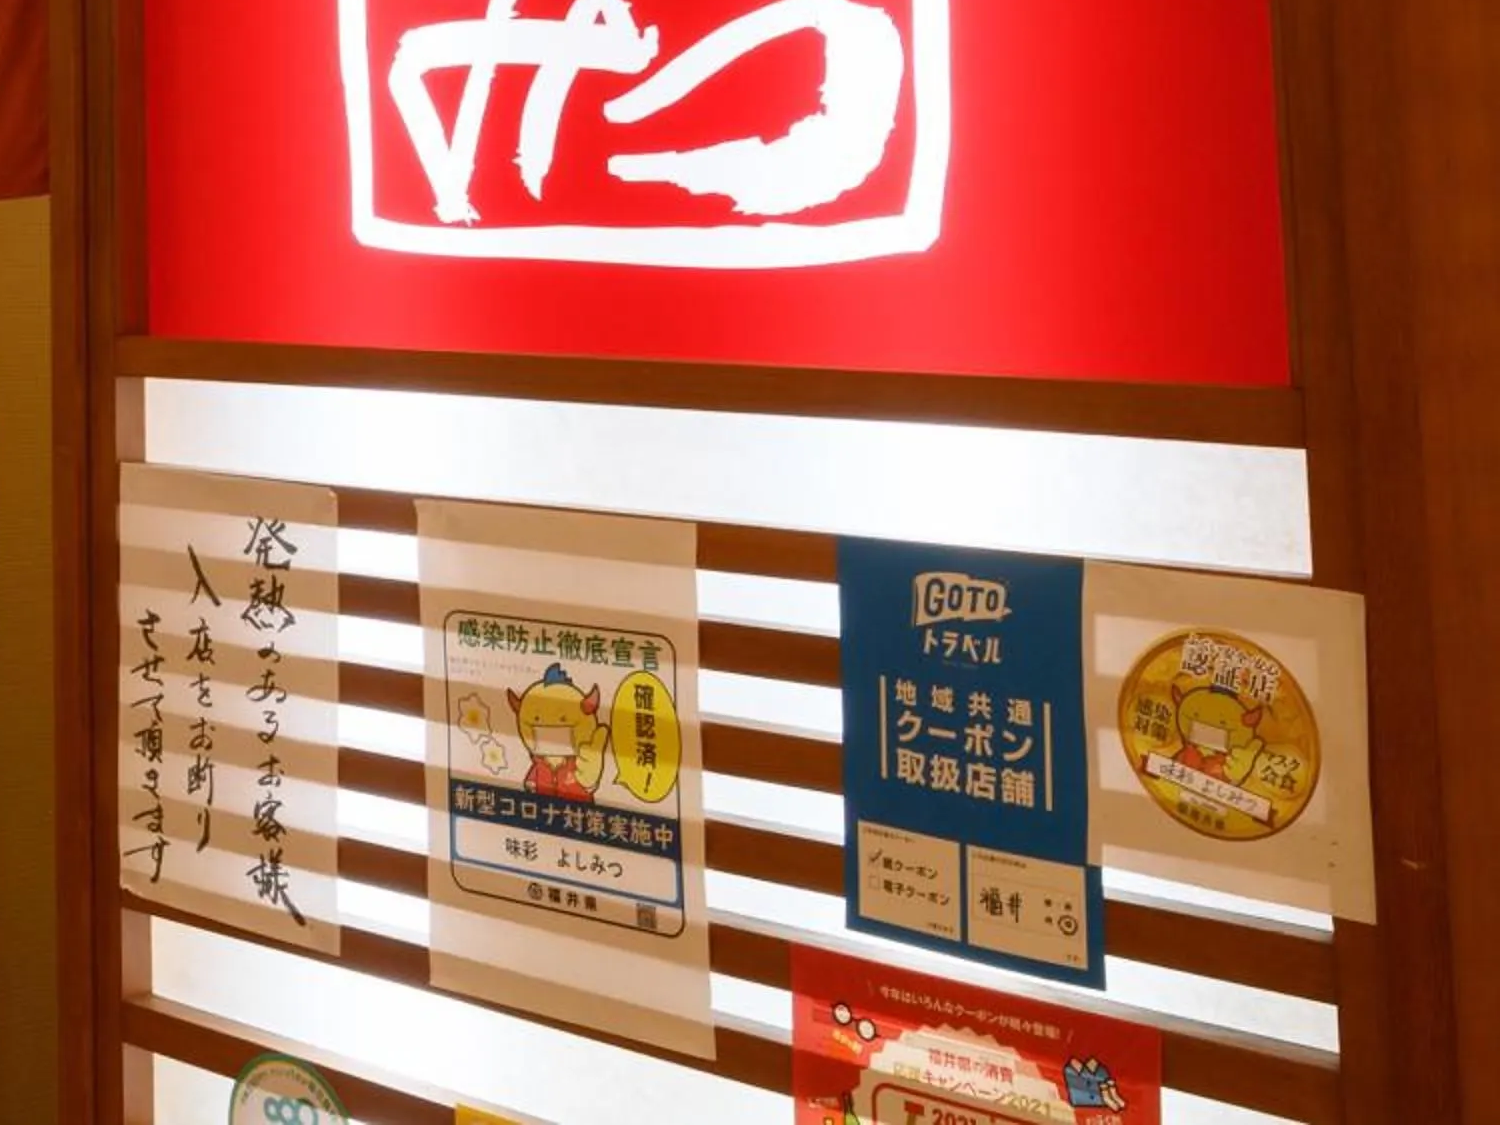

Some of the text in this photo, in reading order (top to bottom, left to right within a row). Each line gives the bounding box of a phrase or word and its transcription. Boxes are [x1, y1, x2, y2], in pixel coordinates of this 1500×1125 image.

[457, 619, 663, 672] 感染防止徹底宣言
[923, 628, 1002, 664] トラベル
[895, 678, 1033, 727] 地域共通
[896, 711, 1033, 763] クーポン
[896, 748, 1035, 808] 取扱店舗
[454, 786, 674, 850] 新型コロナ対策実施中
[504, 836, 624, 878] 味彩 よしみつ
